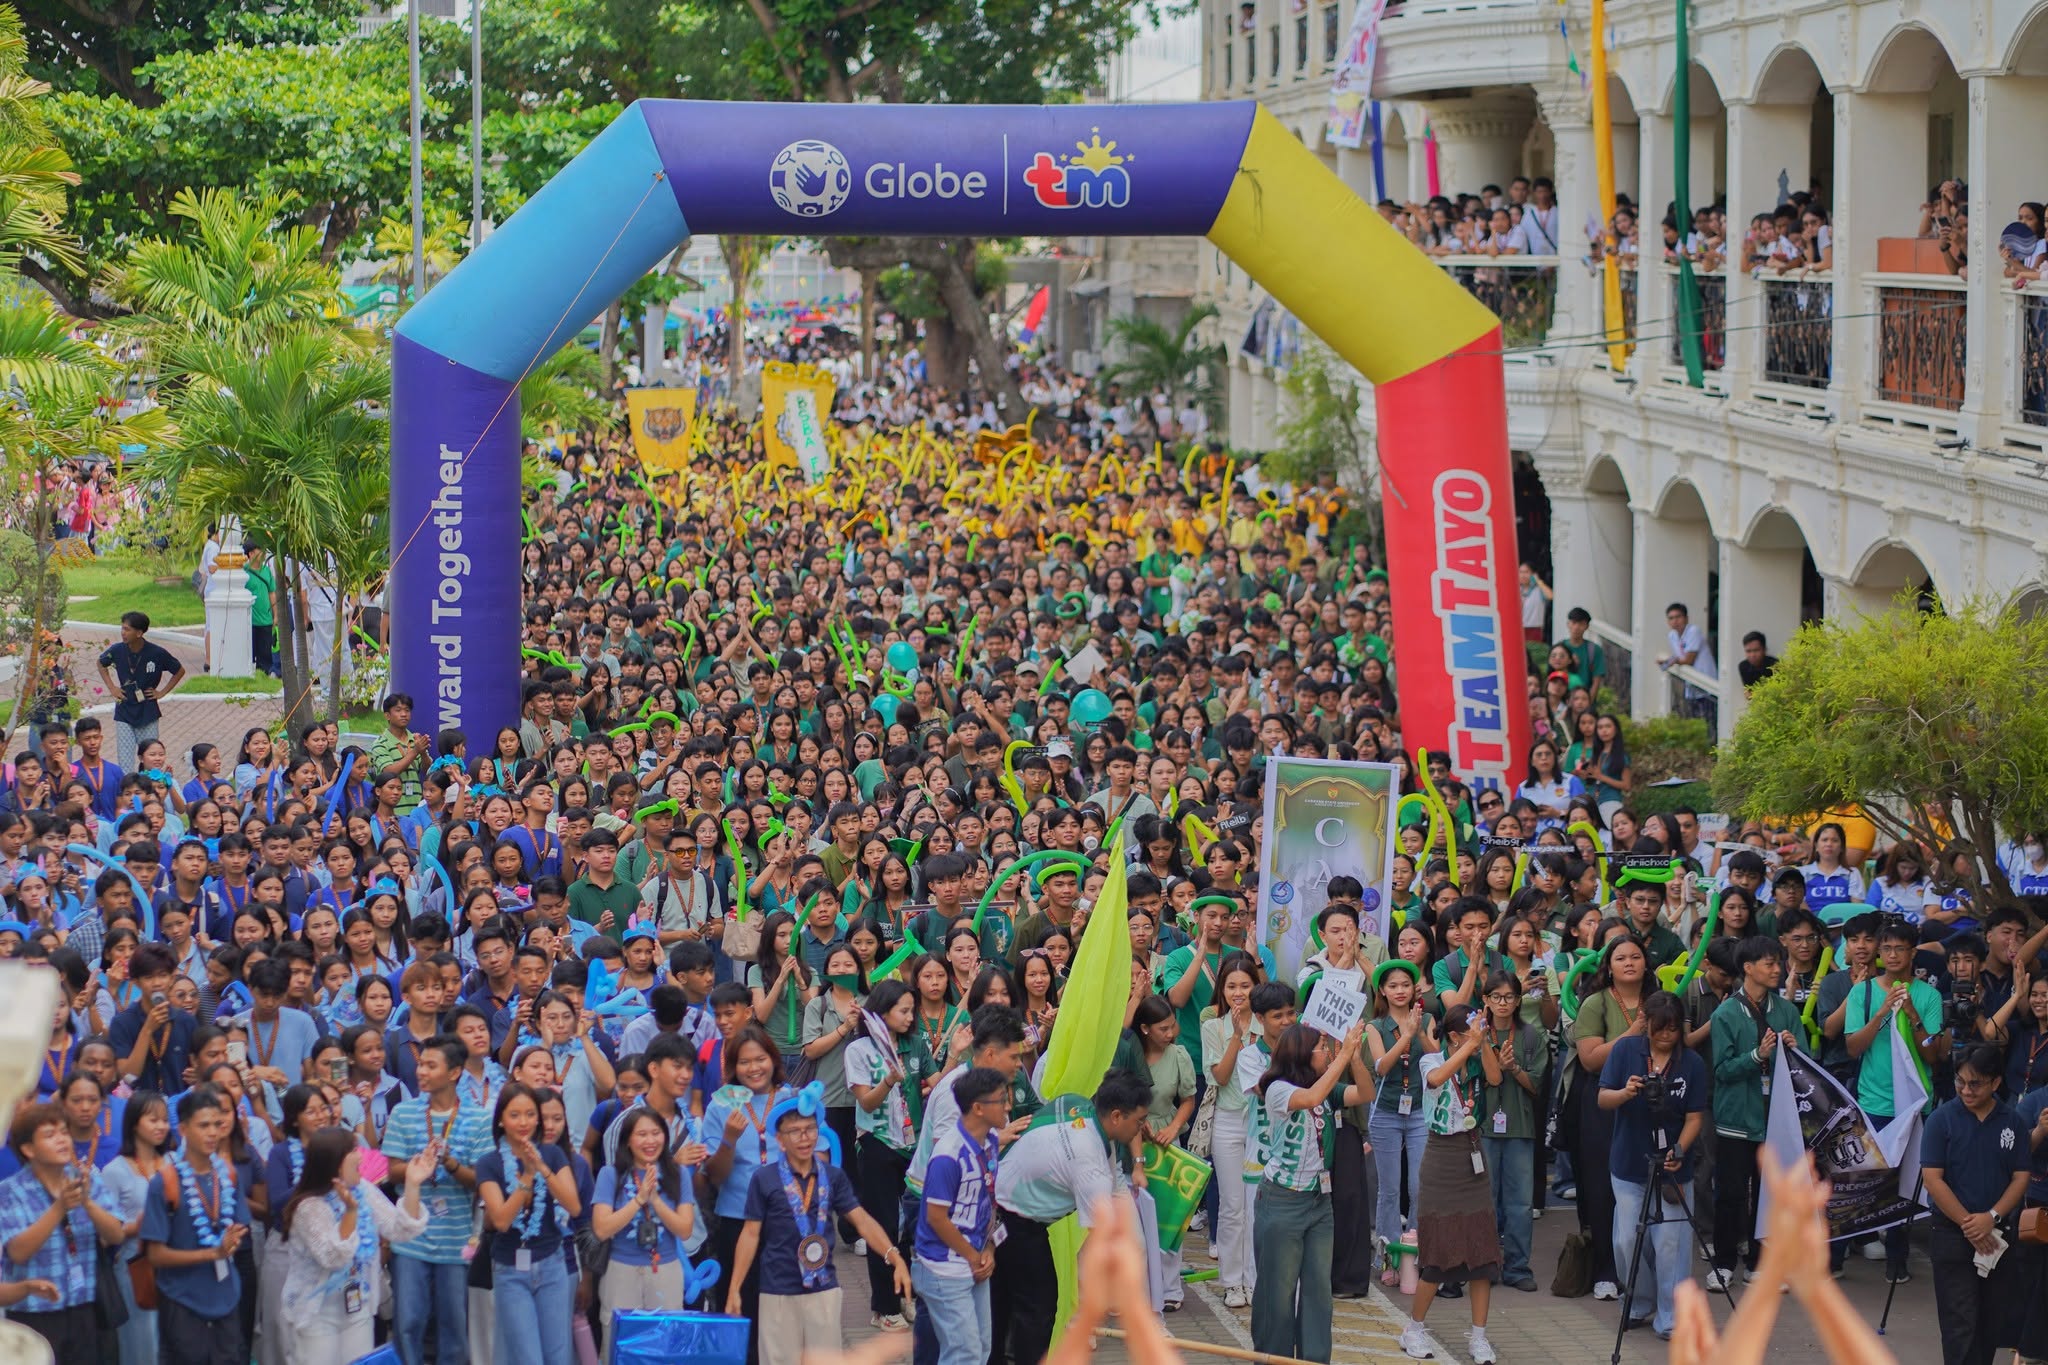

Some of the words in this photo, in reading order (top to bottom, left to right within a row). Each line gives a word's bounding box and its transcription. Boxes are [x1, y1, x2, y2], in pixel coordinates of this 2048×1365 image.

[864, 162, 987, 198] Globe
[1023, 152, 1131, 208] tm
[431, 443, 472, 625] Together
[1811, 885, 1846, 898] CTE
[1883, 897, 1920, 925] CTD
[1316, 1003, 1348, 1031] WAY
[1324, 988, 1355, 1017] THIS
